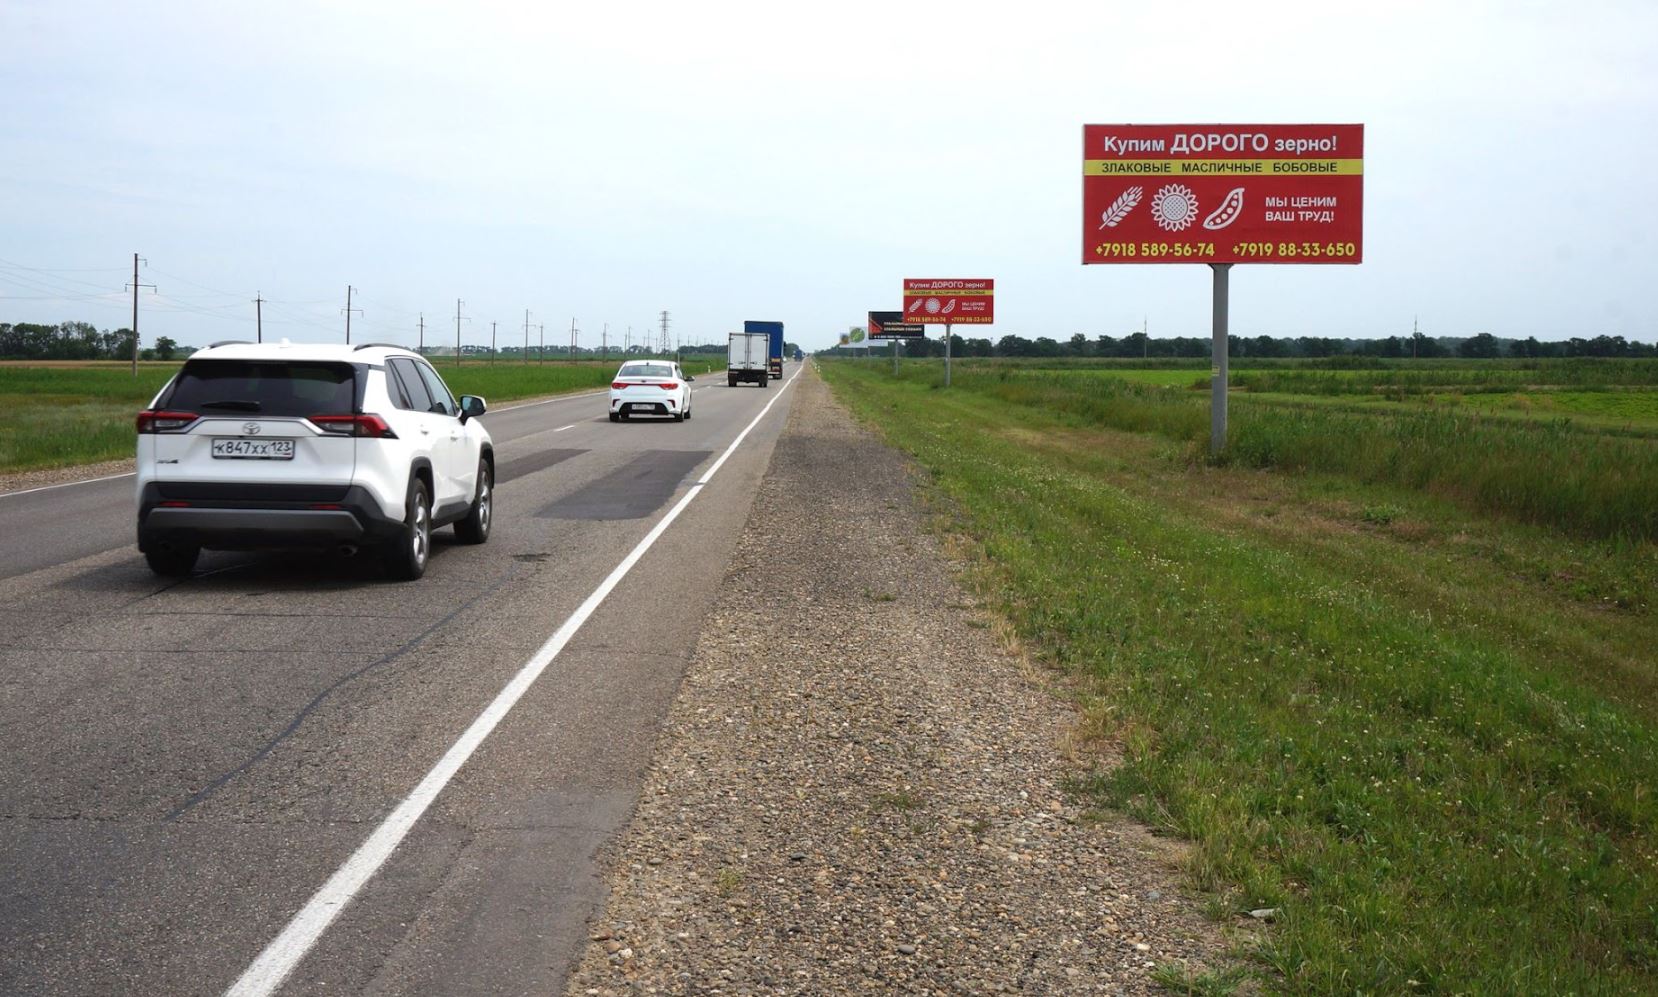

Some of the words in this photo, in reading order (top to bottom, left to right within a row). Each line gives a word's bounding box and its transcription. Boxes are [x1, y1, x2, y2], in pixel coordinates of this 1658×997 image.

[1104, 136, 1164, 156] Купим
[1170, 133, 1269, 155] ДОРОГО
[1274, 136, 1337, 156] зерно!
[1101, 162, 1172, 173] ЗЛАКОВЫЕ
[1181, 162, 1262, 173] МАСЛИЧНЫЕ
[1273, 162, 1338, 173] БОБОВЫЕ
[1265, 196, 1287, 207] МЫ
[1291, 196, 1337, 209] ЦЕНИМ
[1265, 211, 1295, 222] ВАШ
[1297, 211, 1335, 223] ТРУД!
[1095, 243, 1136, 257] +7918
[1140, 243, 1216, 257] 589-56-74
[1232, 243, 1273, 257] +7919
[1278, 243, 1355, 257] 88-33-650
[931, 281, 964, 289] ДОРОГО
[270, 441, 291, 452] 123
